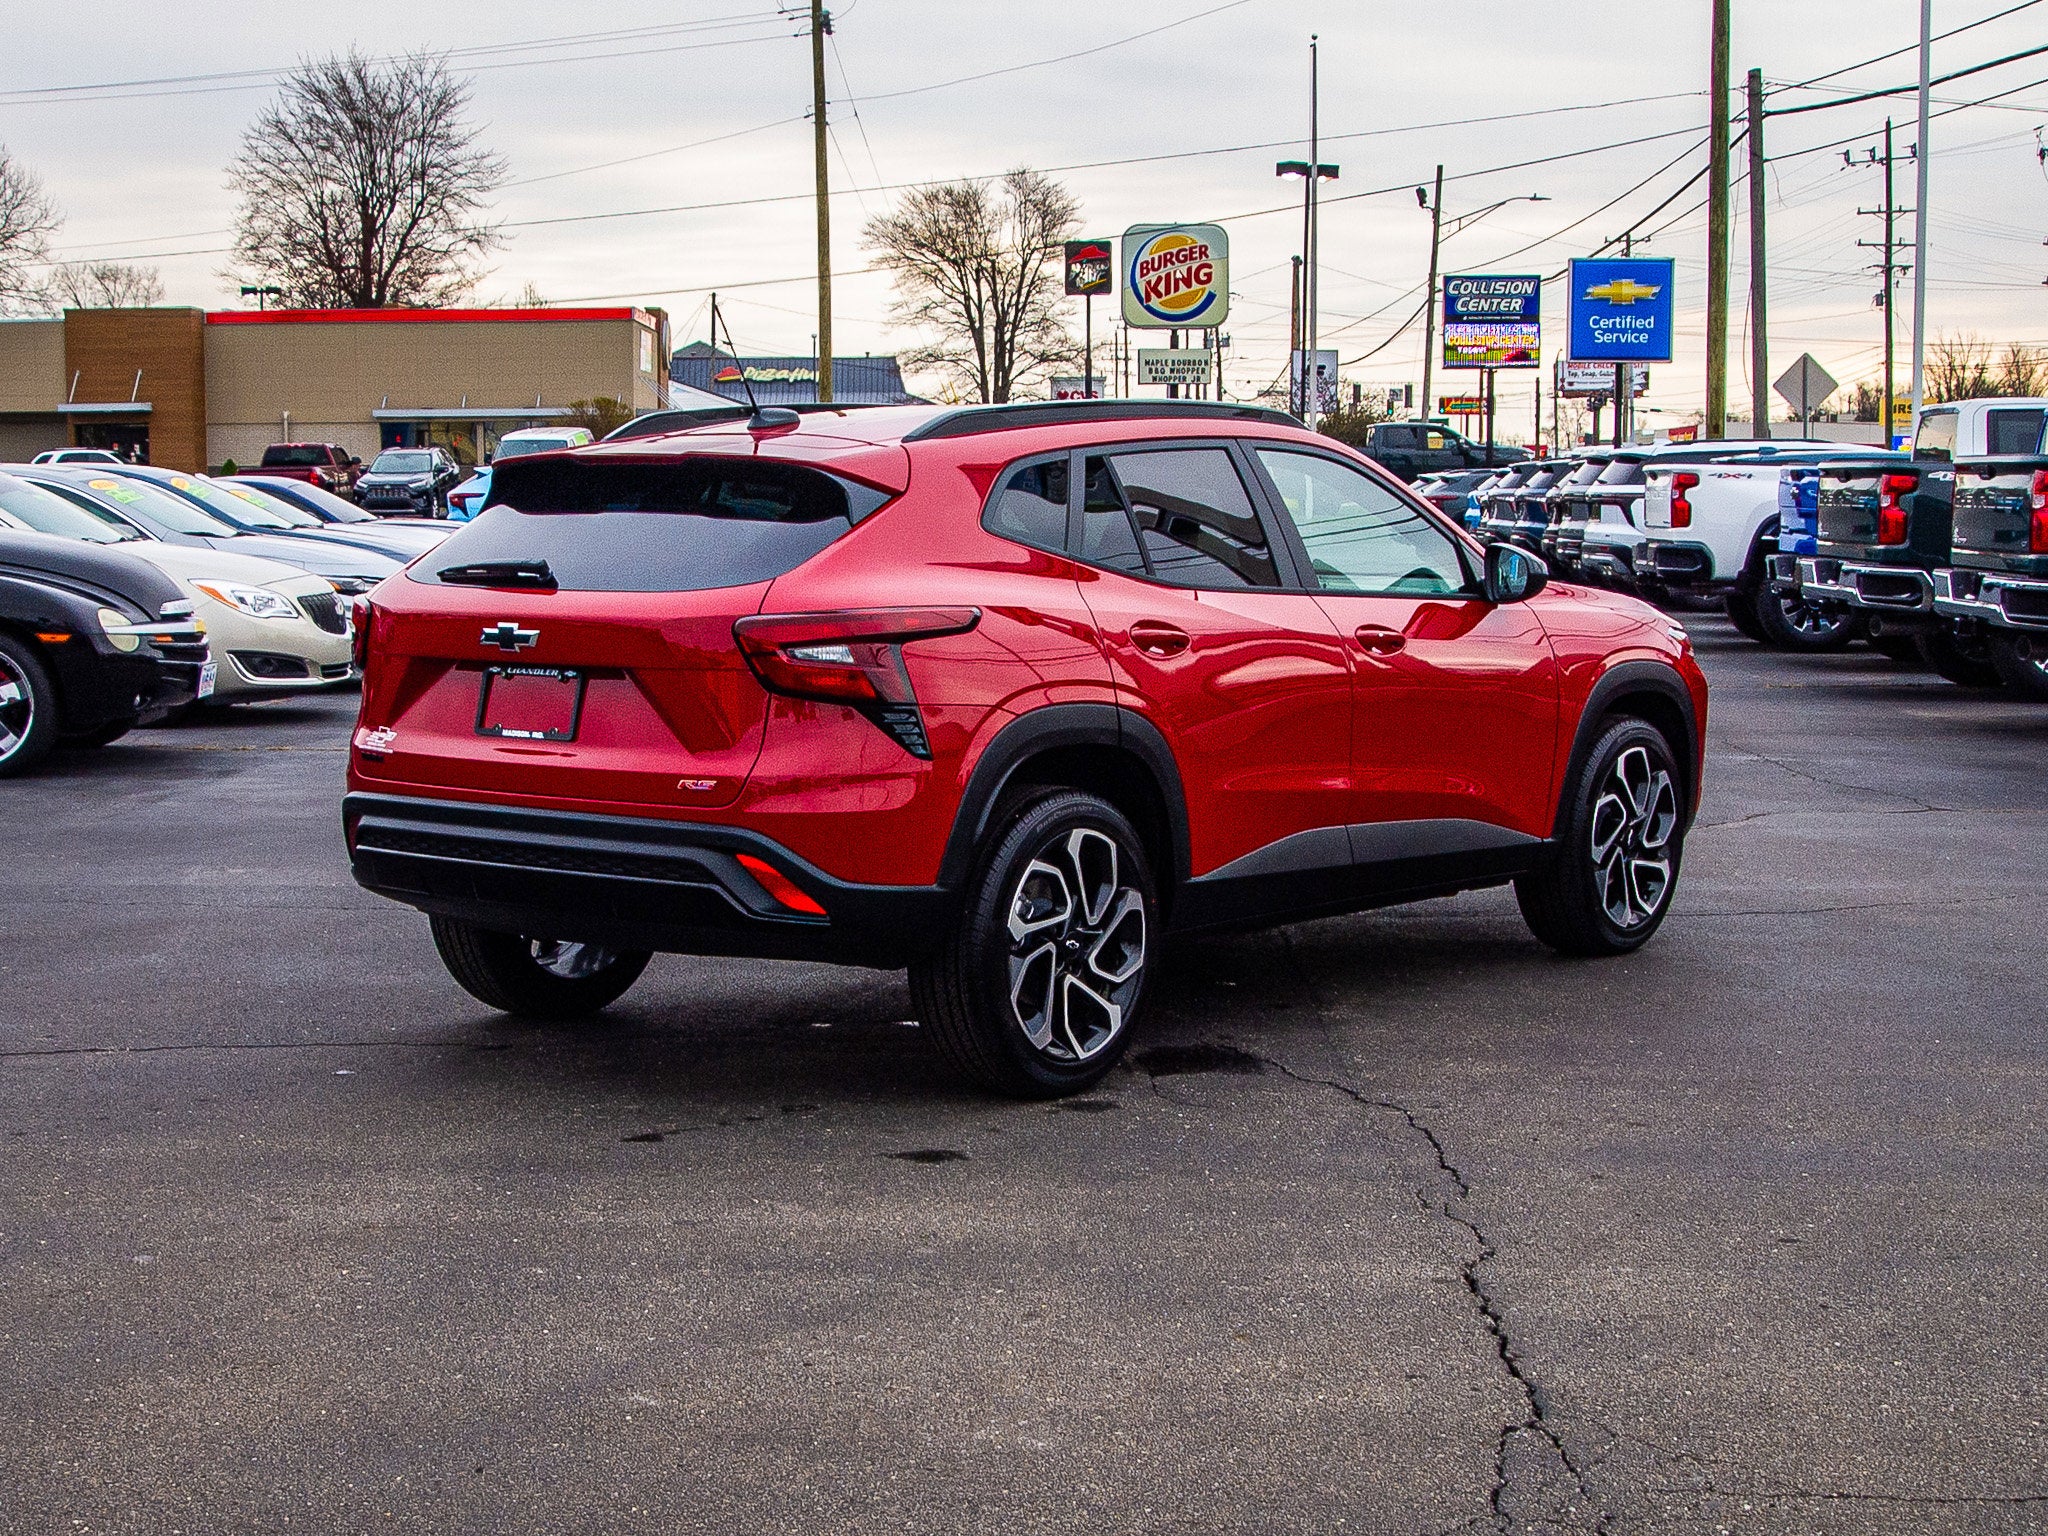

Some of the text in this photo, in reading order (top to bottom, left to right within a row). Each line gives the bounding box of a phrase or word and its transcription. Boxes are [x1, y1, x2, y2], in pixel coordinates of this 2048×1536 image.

[1139, 244, 1210, 279] BURGER
[1144, 262, 1213, 304] KING
[1448, 280, 1536, 295] COLLISION
[1456, 297, 1523, 312] CENTER
[1589, 315, 1655, 329] Certified
[1594, 329, 1649, 343] Service
[677, 779, 718, 791] RS
